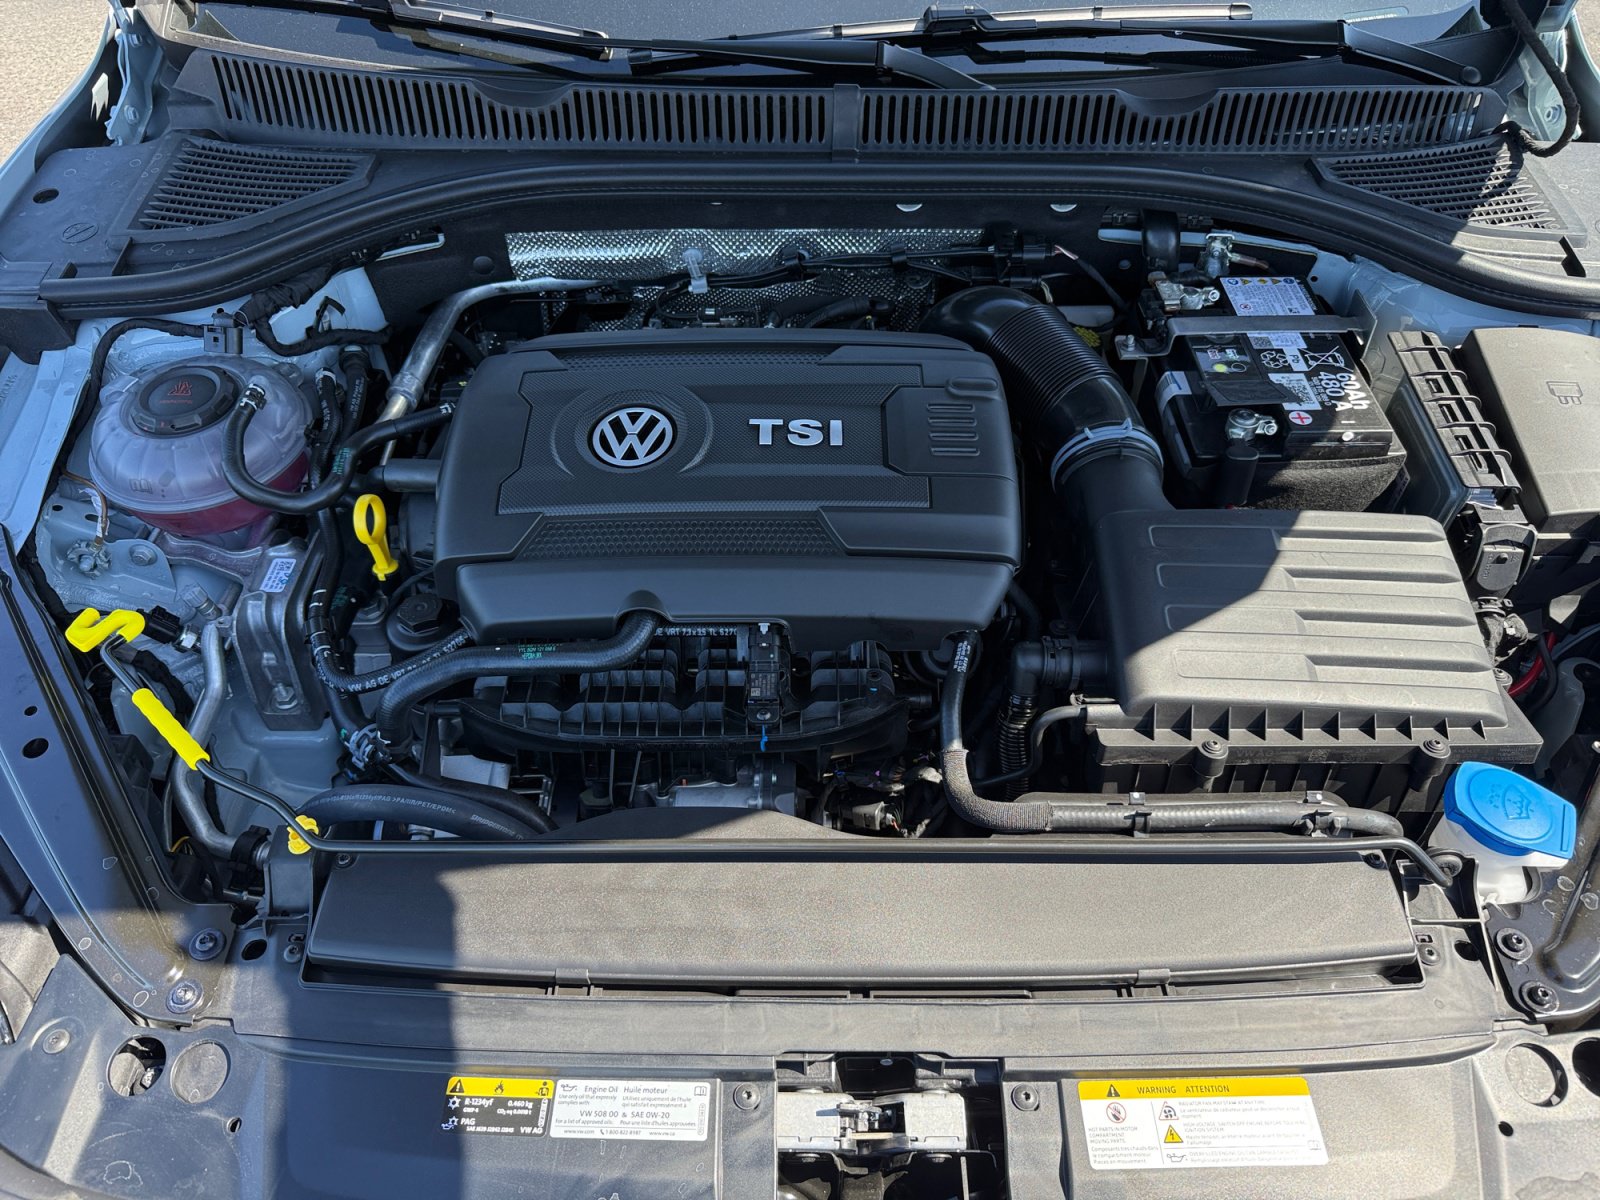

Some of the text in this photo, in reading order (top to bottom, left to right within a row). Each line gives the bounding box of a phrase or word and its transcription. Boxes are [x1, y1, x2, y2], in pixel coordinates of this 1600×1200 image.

[1318, 372, 1353, 412] 480 A
[1336, 373, 1370, 409] 60Ah
[748, 418, 843, 446] TSI
[585, 1086, 607, 1094] Engine
[1137, 1086, 1176, 1094] WARNING
[464, 1098, 494, 1107] R-1234yf
